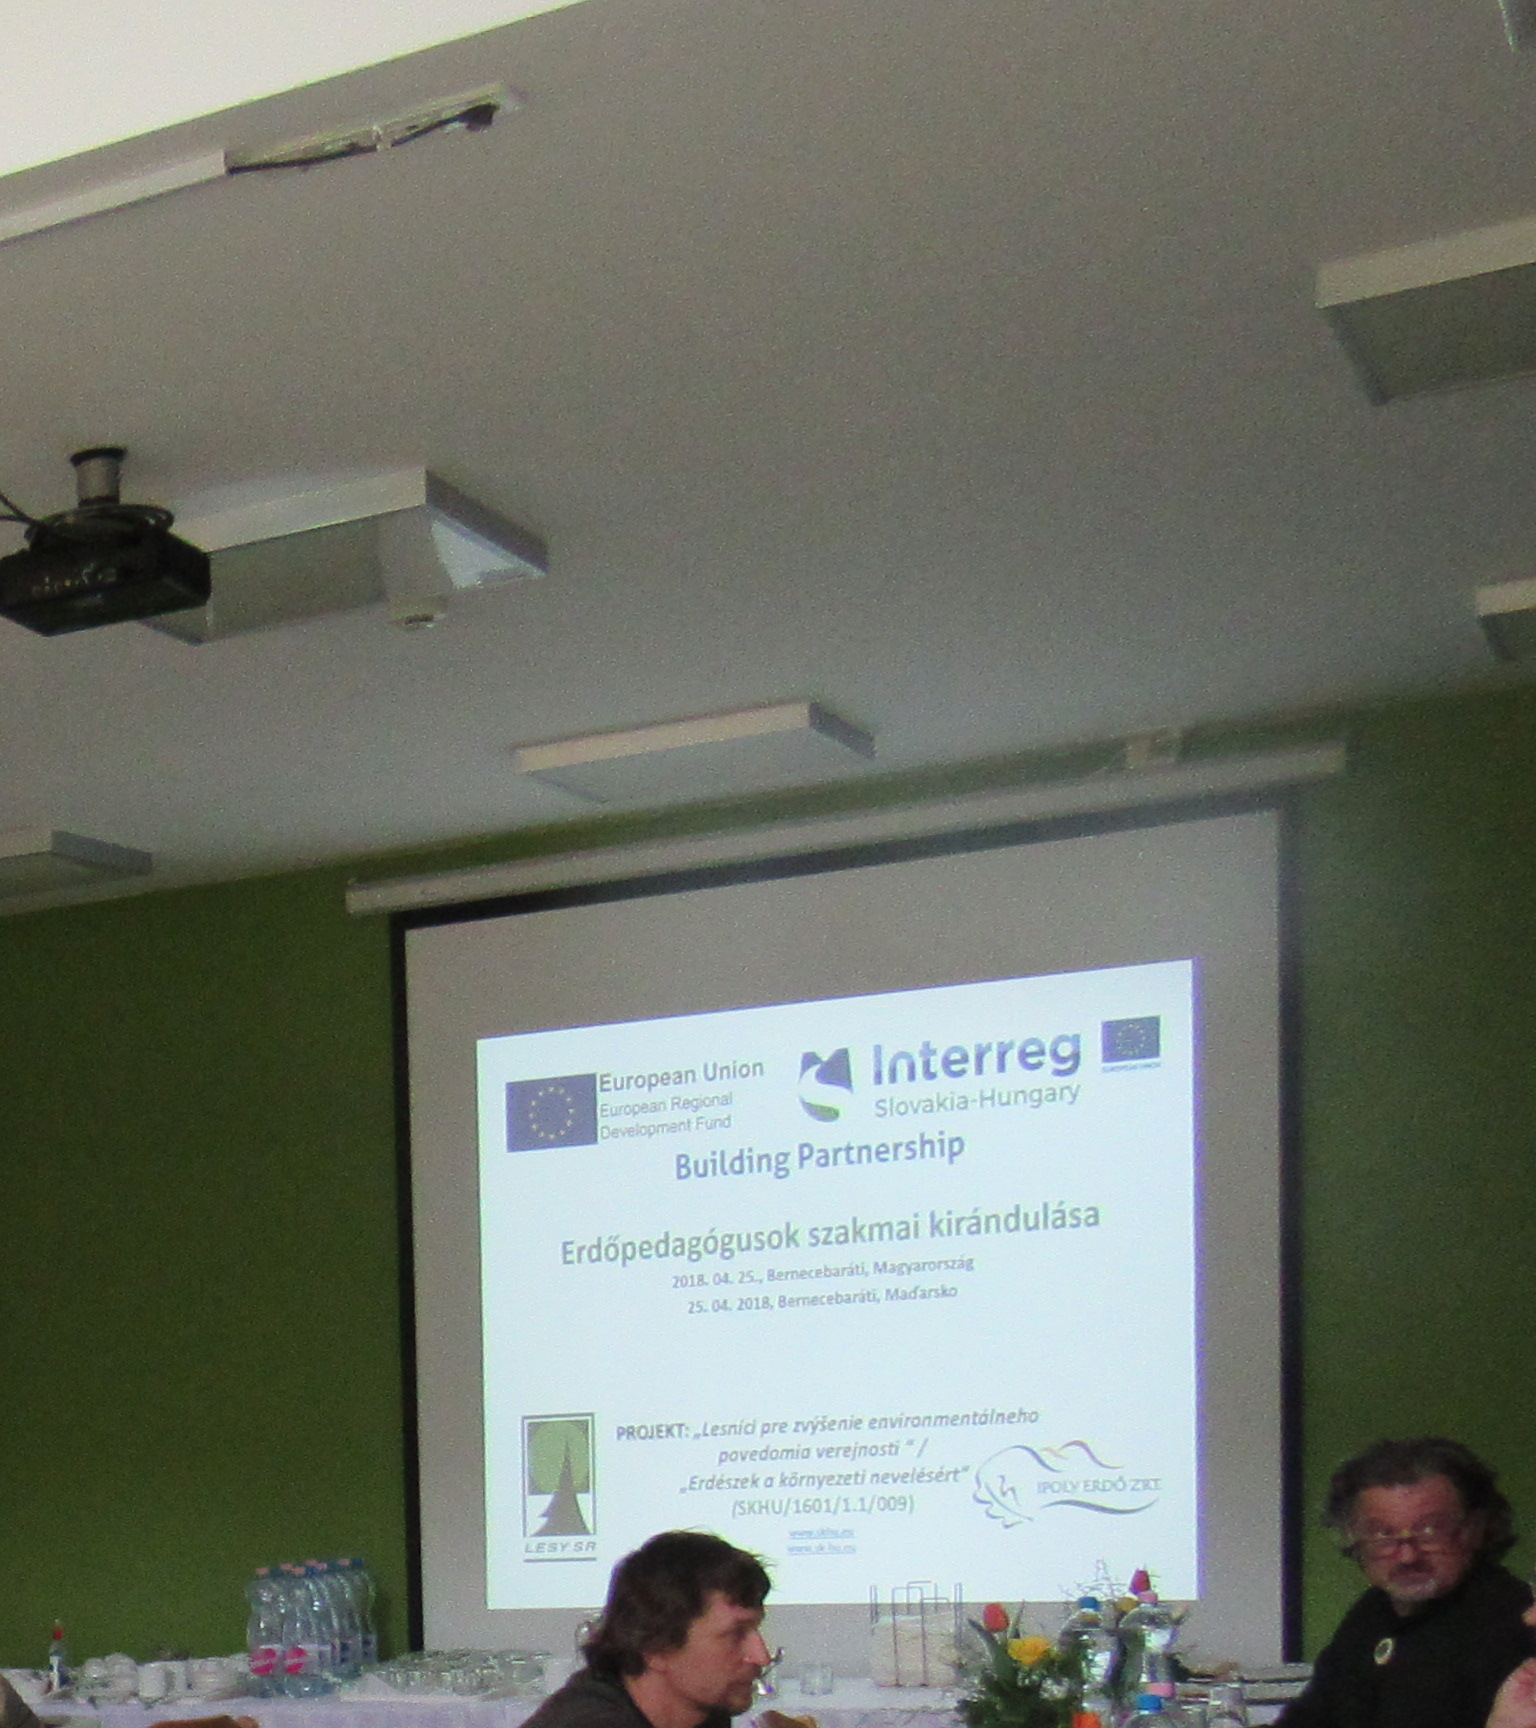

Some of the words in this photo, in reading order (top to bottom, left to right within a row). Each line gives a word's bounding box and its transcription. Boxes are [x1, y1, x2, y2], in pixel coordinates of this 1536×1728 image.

[872, 1032, 1082, 1086] Interreg
[599, 1068, 696, 1093] European
[703, 1061, 764, 1082] Union
[600, 1101, 667, 1118] European
[671, 1092, 733, 1113] Regional
[875, 1082, 1081, 1118] Slovakia-Hungary
[600, 1121, 691, 1140] Development
[696, 1115, 731, 1130] Fund
[677, 1147, 791, 1180] Building
[798, 1130, 965, 1168] Partnership
[561, 1221, 800, 1267] Erdőpedagógusok
[808, 1213, 920, 1247] szakmai
[929, 1200, 1100, 1239] kirándulása
[672, 1274, 709, 1289] 2018.
[712, 1272, 734, 1286] 04.
[873, 1254, 975, 1276] Magyarország
[688, 1301, 708, 1315] 25.
[711, 1299, 733, 1313] 04.
[616, 1423, 690, 1441] PROJEKT:
[760, 1420, 788, 1437] pre
[792, 1415, 863, 1436] zvýšenie
[868, 1407, 1040, 1430] environmentálneho
[816, 1441, 901, 1461] verejnosti
[778, 1469, 865, 1490] környezeti
[732, 1494, 914, 1520] (SKHU/1601/1.1/009)
[524, 1542, 568, 1553] LESY
[572, 1541, 597, 1552] SR
